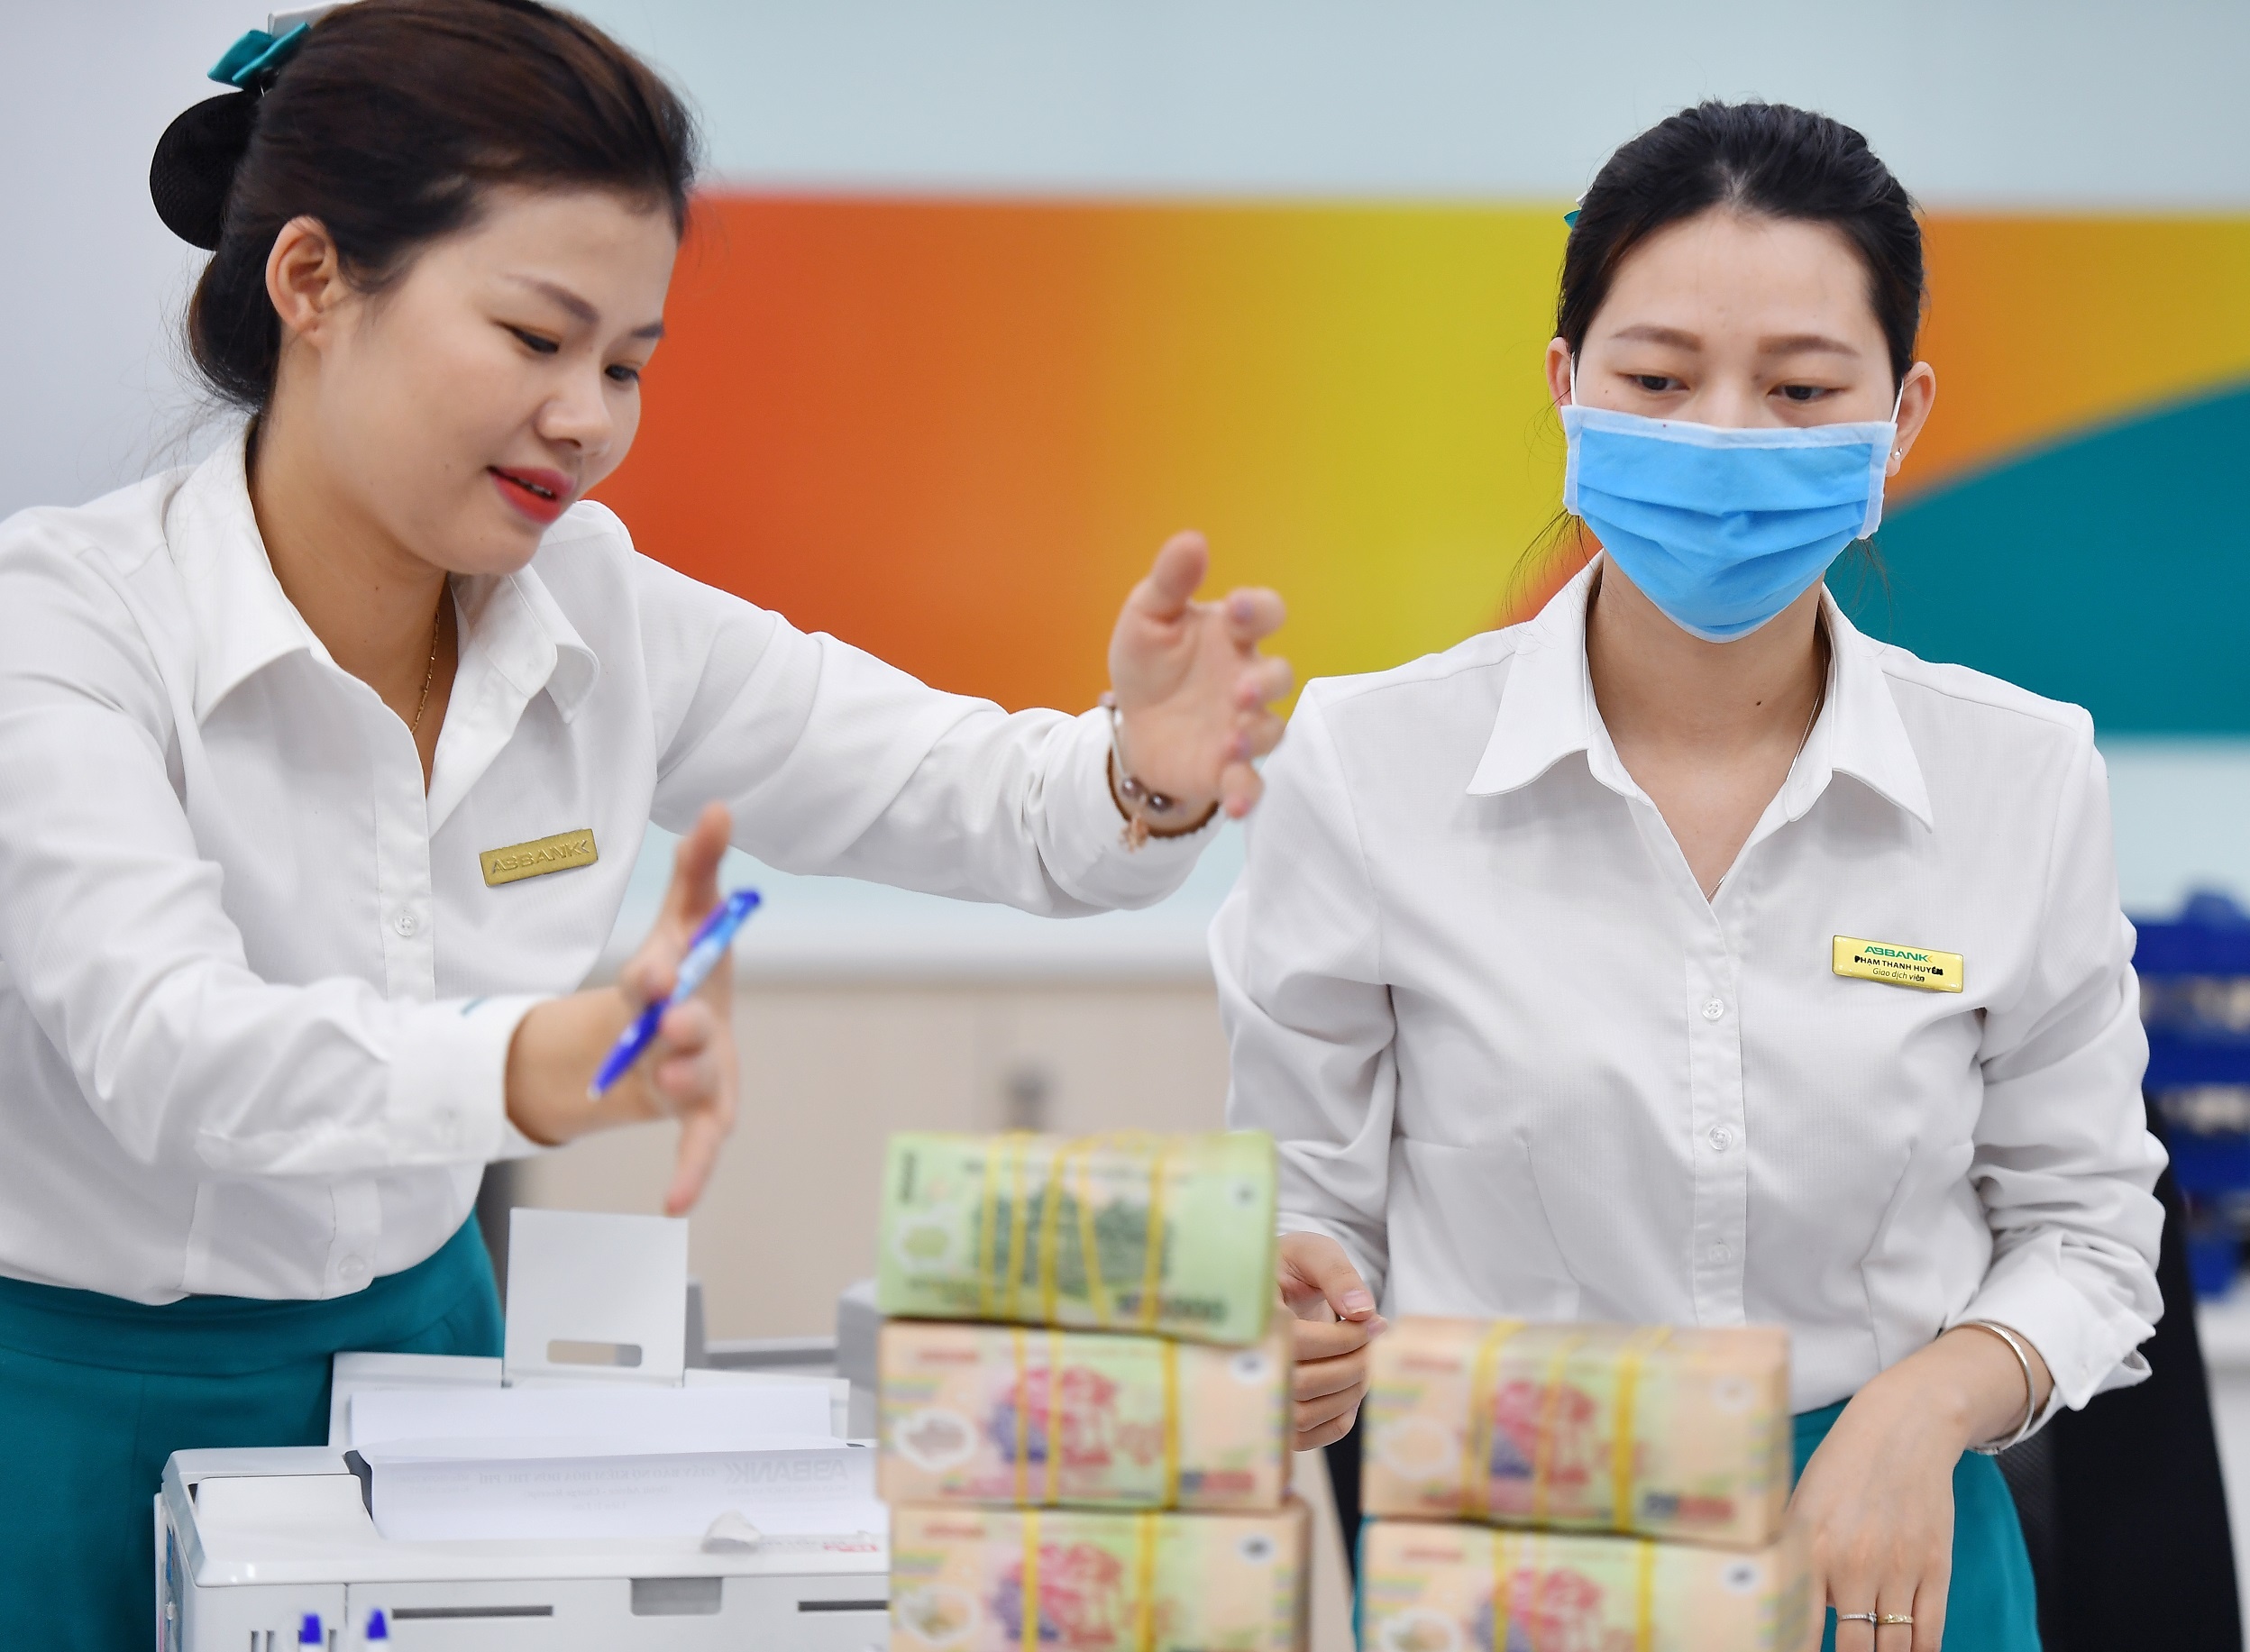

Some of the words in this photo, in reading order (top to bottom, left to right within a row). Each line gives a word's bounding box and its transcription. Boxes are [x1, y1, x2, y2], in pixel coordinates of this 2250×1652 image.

[491, 839, 590, 874] ABBANK
[1864, 946, 1933, 963] ABBANK
[1872, 967, 1890, 976] Giao
[1892, 971, 1907, 980] dịch
[1909, 973, 1925, 982] viên
[1882, 960, 1911, 971] THANH
[1914, 964, 1944, 976] HUY
